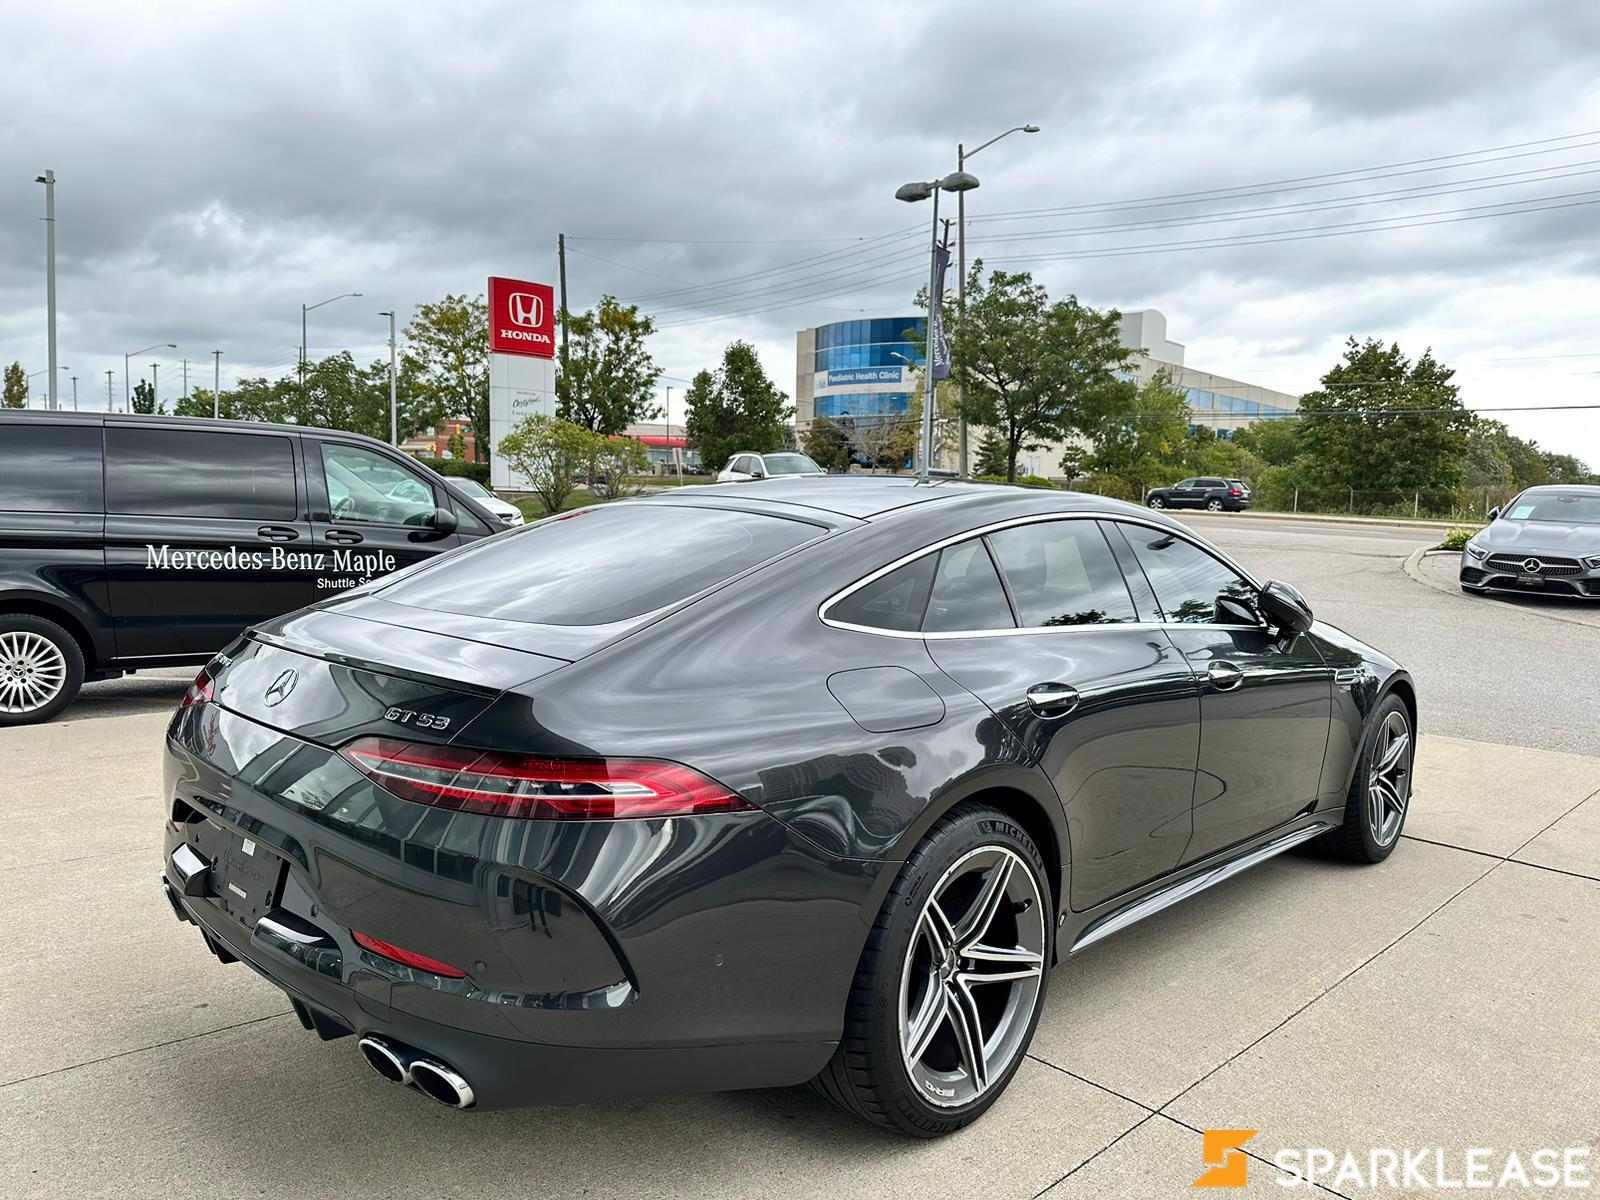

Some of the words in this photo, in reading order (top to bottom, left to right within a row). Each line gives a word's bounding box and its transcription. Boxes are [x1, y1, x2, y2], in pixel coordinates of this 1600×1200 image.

[500, 329, 551, 344] HONDA
[855, 371, 878, 381] Health
[878, 369, 900, 380] Clinic
[145, 544, 325, 570] Mercedes-Benz
[332, 549, 396, 577] Maple
[317, 577, 356, 589] Shuttle
[384, 706, 417, 723] GT
[416, 712, 451, 730] 53
